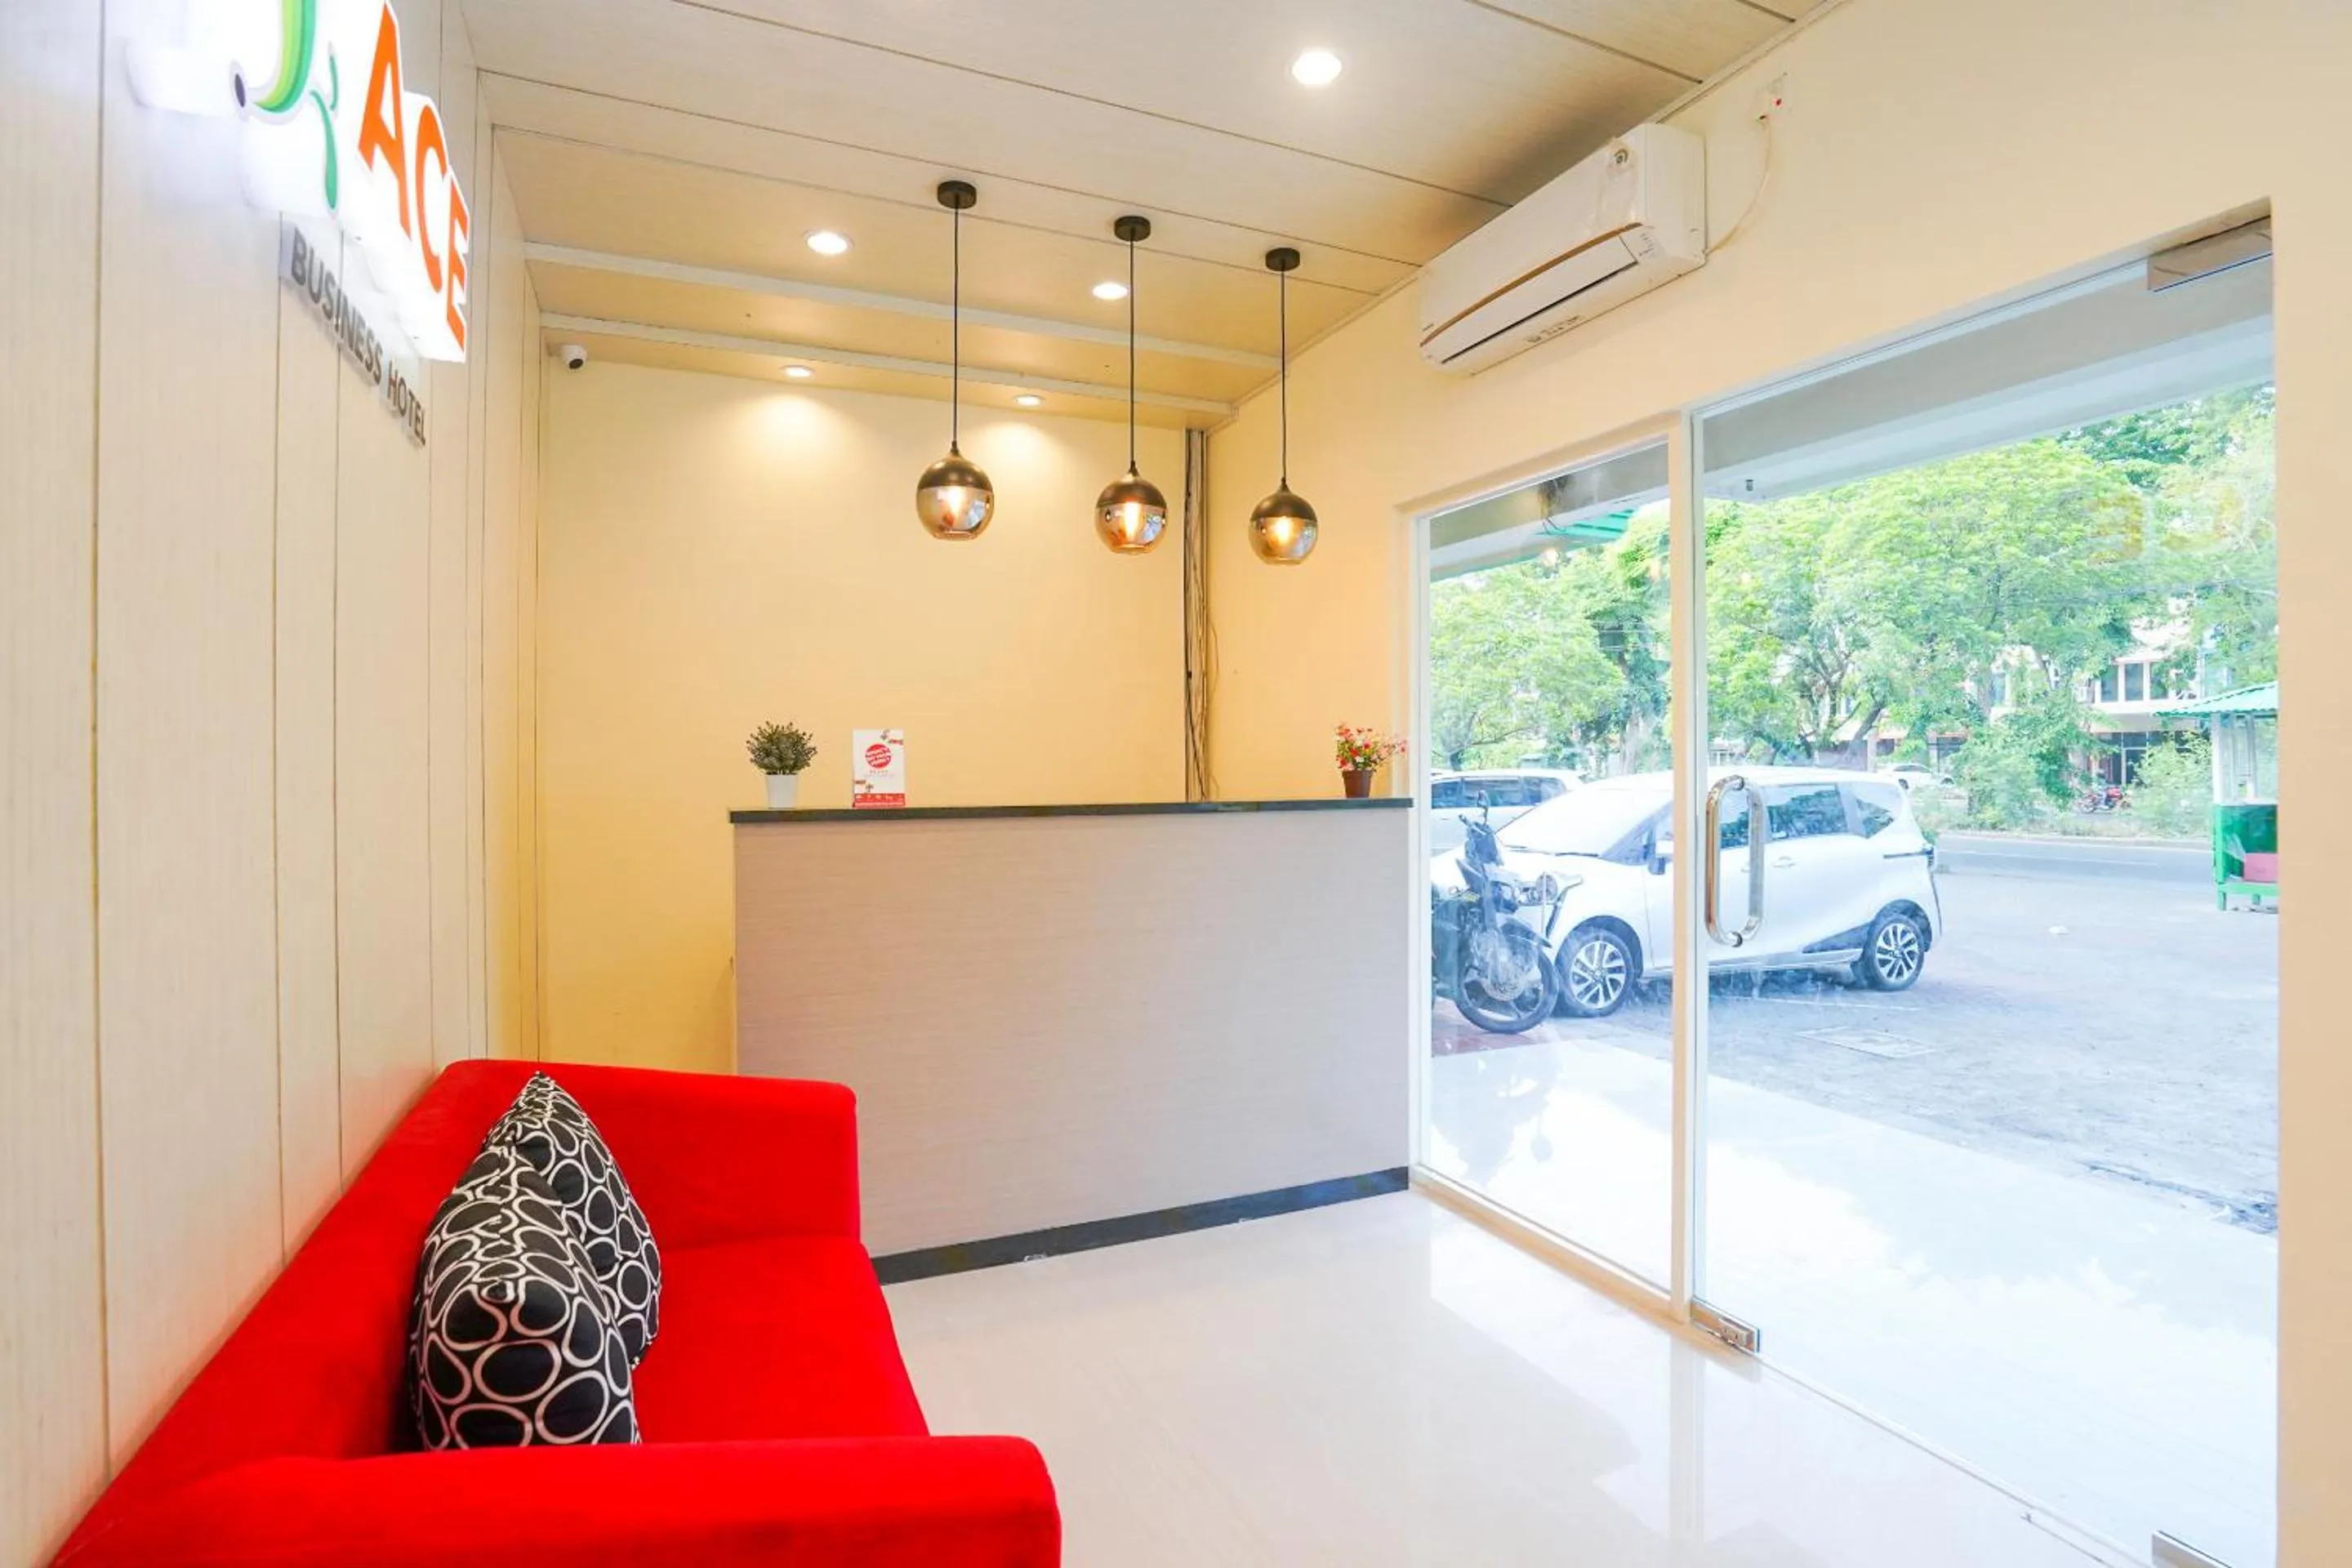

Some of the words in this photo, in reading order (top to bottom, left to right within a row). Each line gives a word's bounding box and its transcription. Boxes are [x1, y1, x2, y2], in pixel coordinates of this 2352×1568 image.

[358, 2, 469, 354] ACE
[291, 225, 384, 385] BUSINESS
[386, 359, 425, 446] HOTEL
